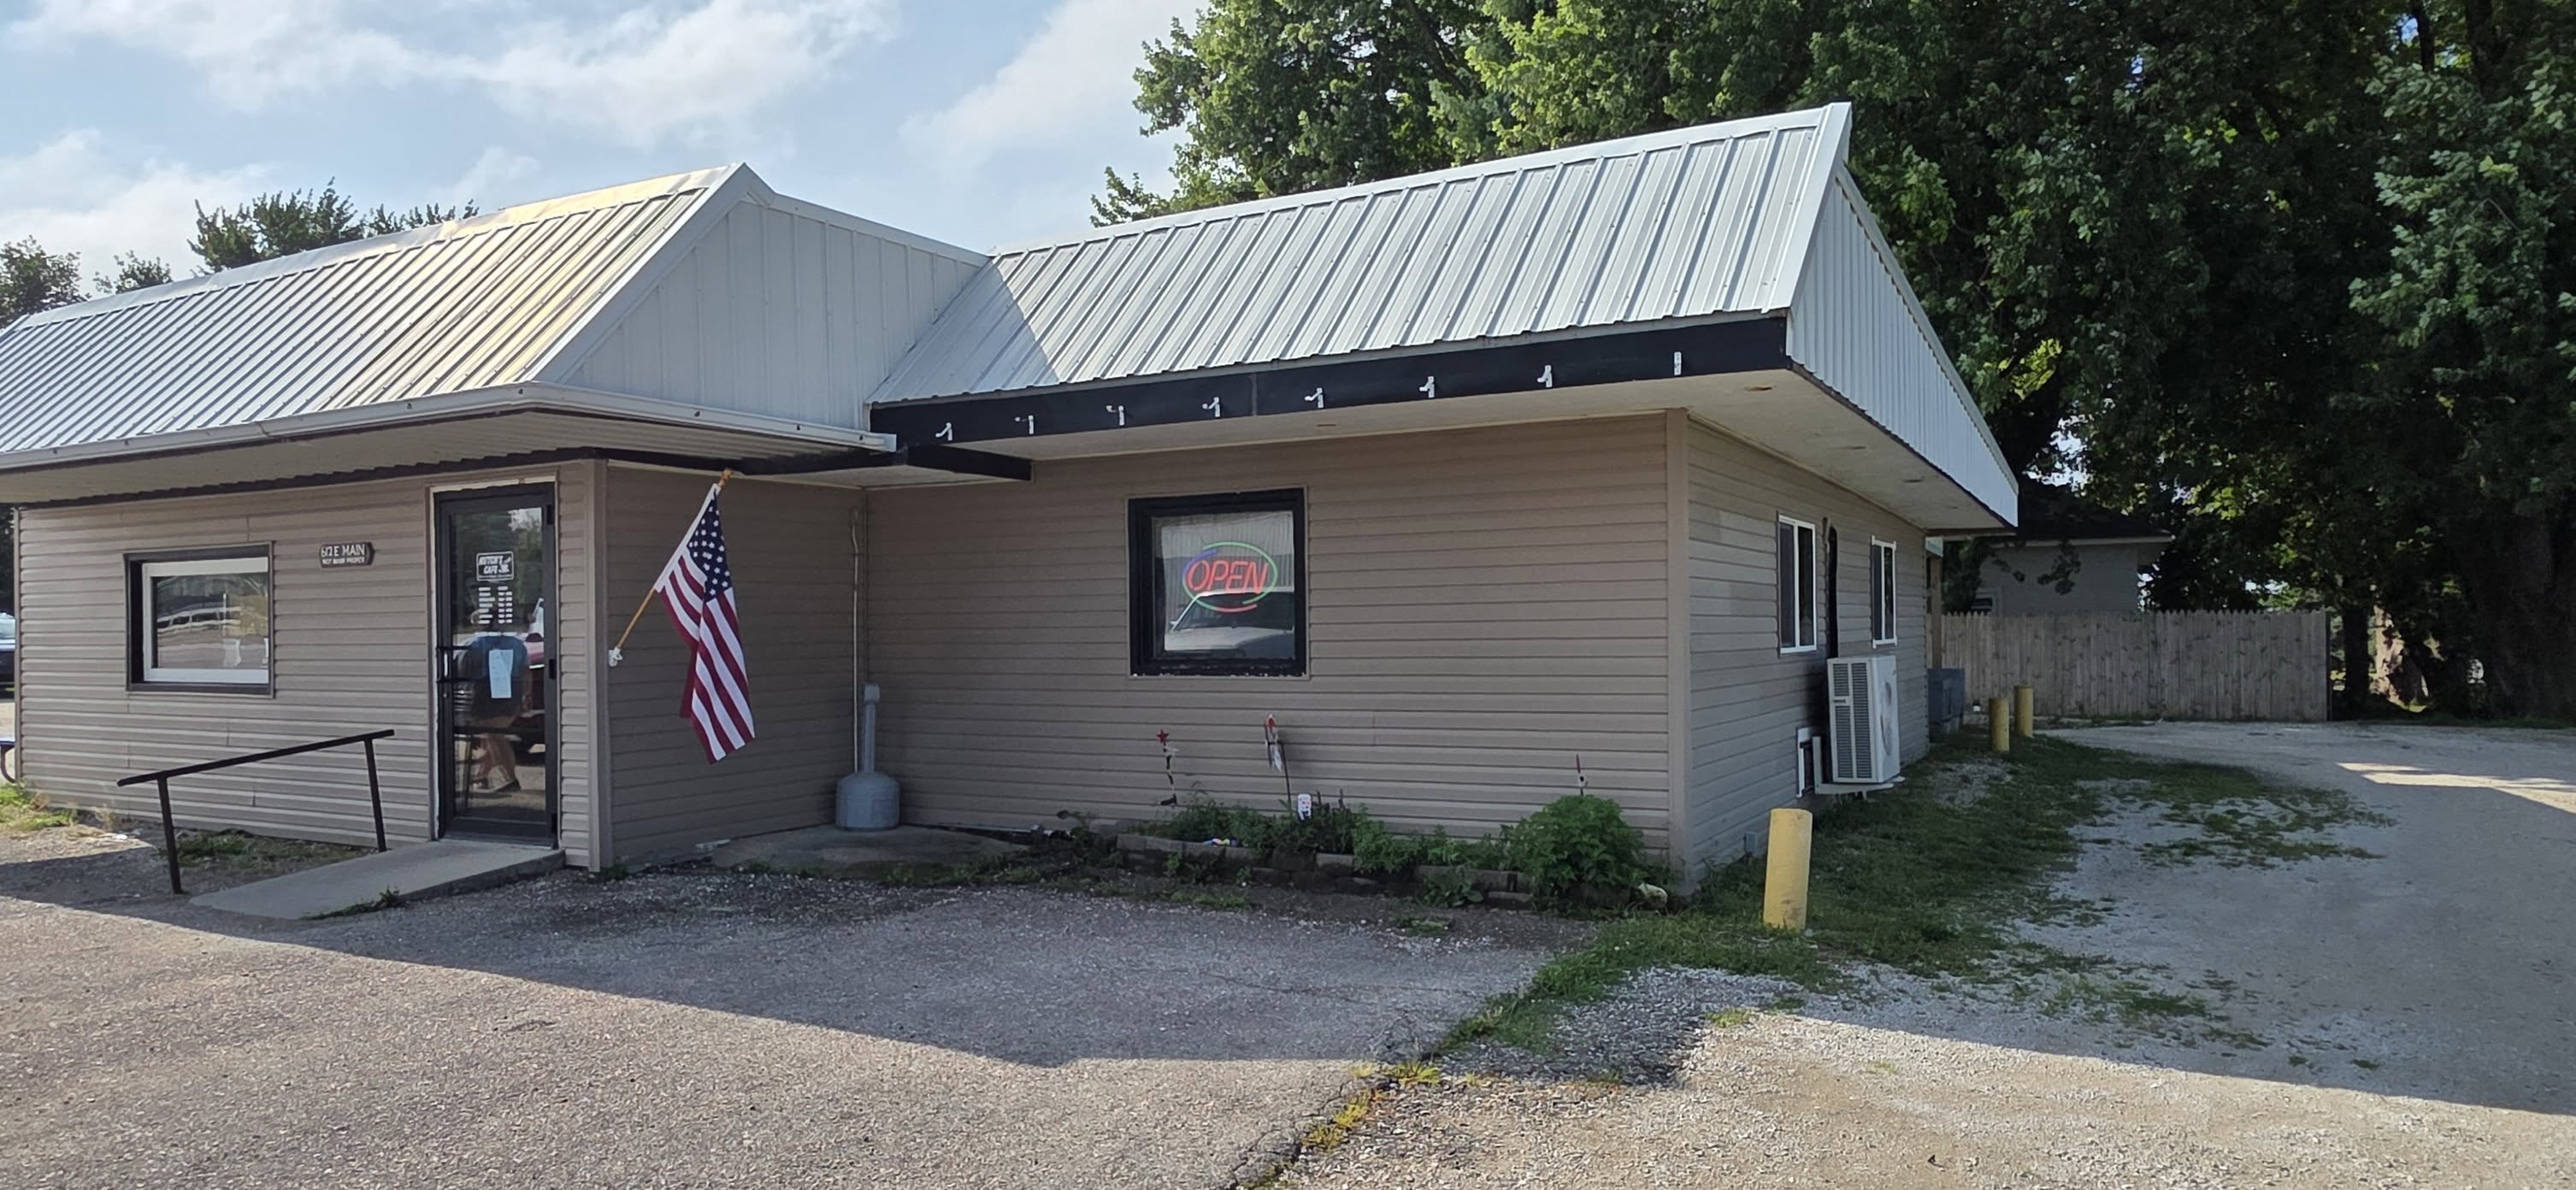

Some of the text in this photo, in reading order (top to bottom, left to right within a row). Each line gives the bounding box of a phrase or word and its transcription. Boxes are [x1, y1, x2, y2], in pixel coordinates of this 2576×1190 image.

[333, 545, 339, 557] E
[342, 544, 365, 556] MAIN
[1186, 559, 1270, 594] OPEN
